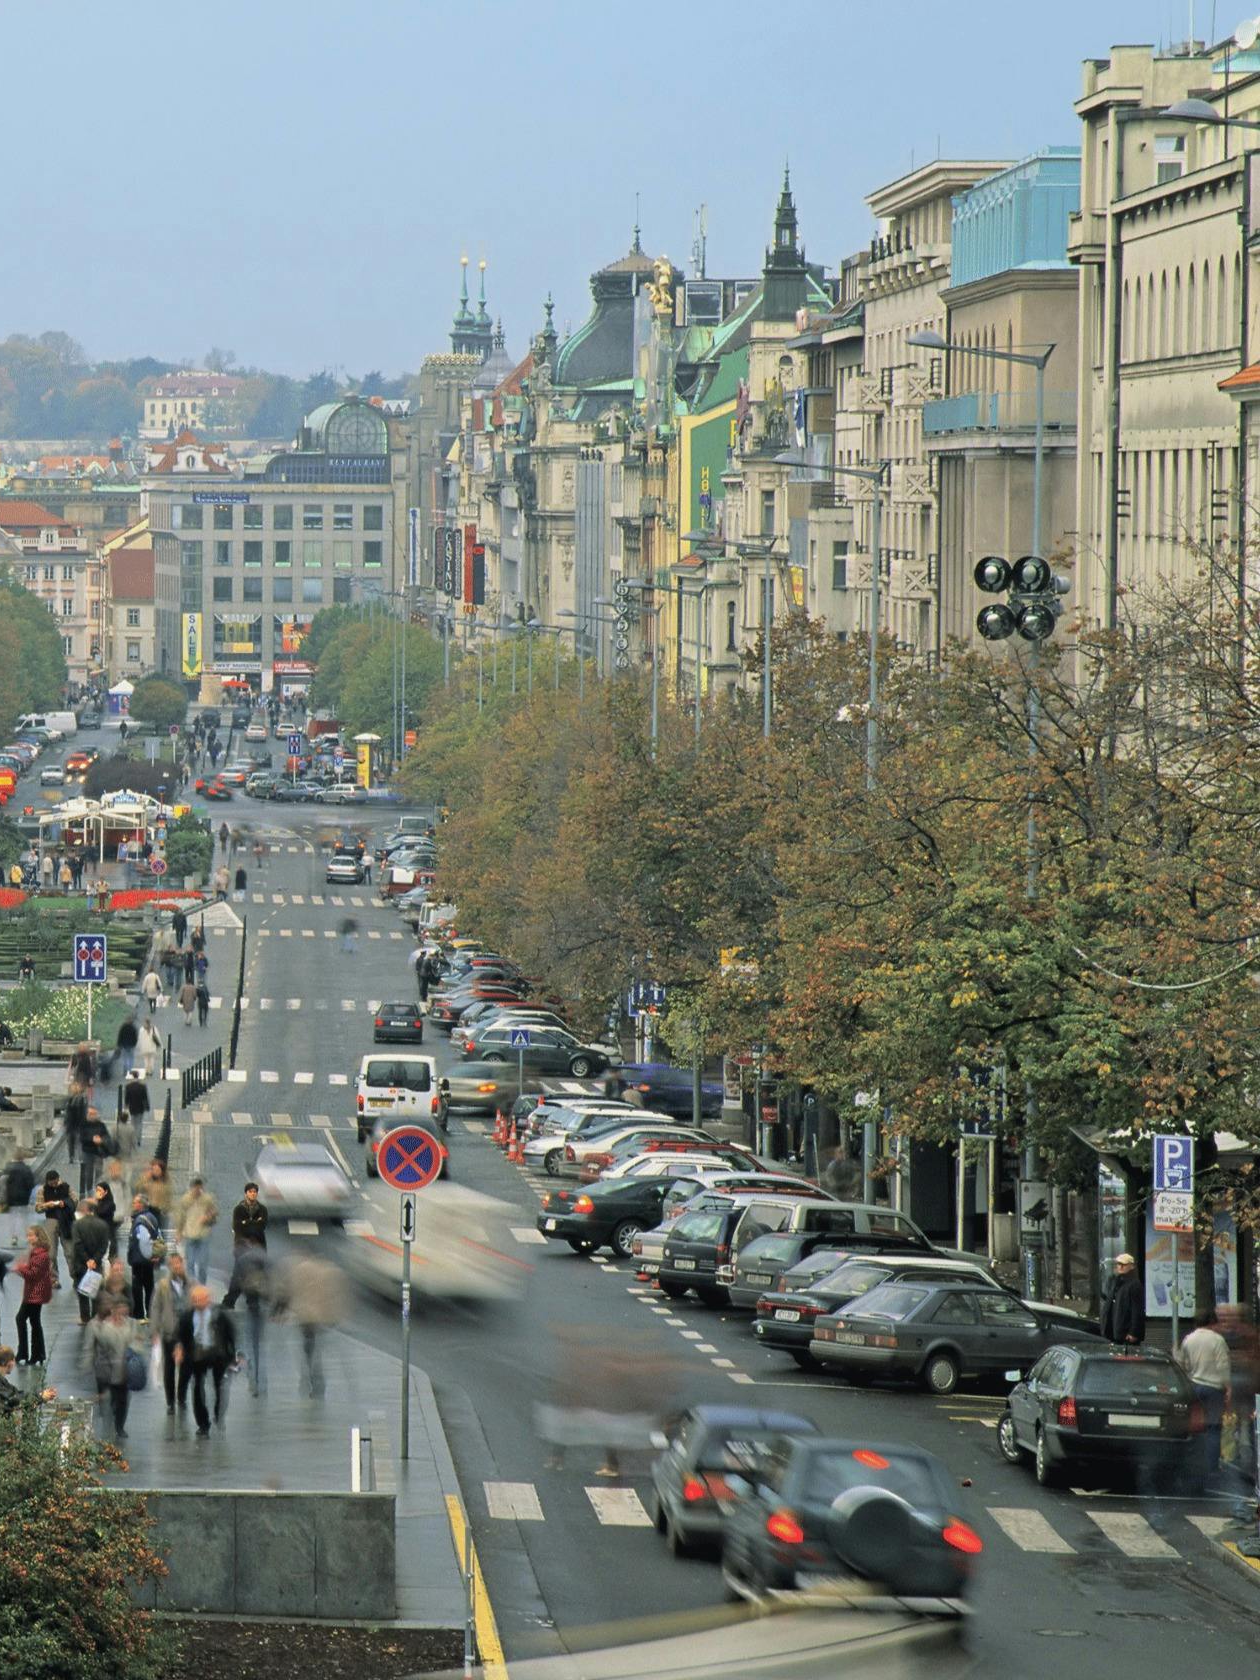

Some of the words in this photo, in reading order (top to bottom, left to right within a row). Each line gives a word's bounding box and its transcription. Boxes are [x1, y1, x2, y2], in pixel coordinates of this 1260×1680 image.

[329, 458, 385, 467] RESTAURANT
[445, 531, 453, 591] CASINO
[188, 614, 196, 657] SALE
[808, 1097, 815, 1106] P
[1164, 1139, 1183, 1169] P
